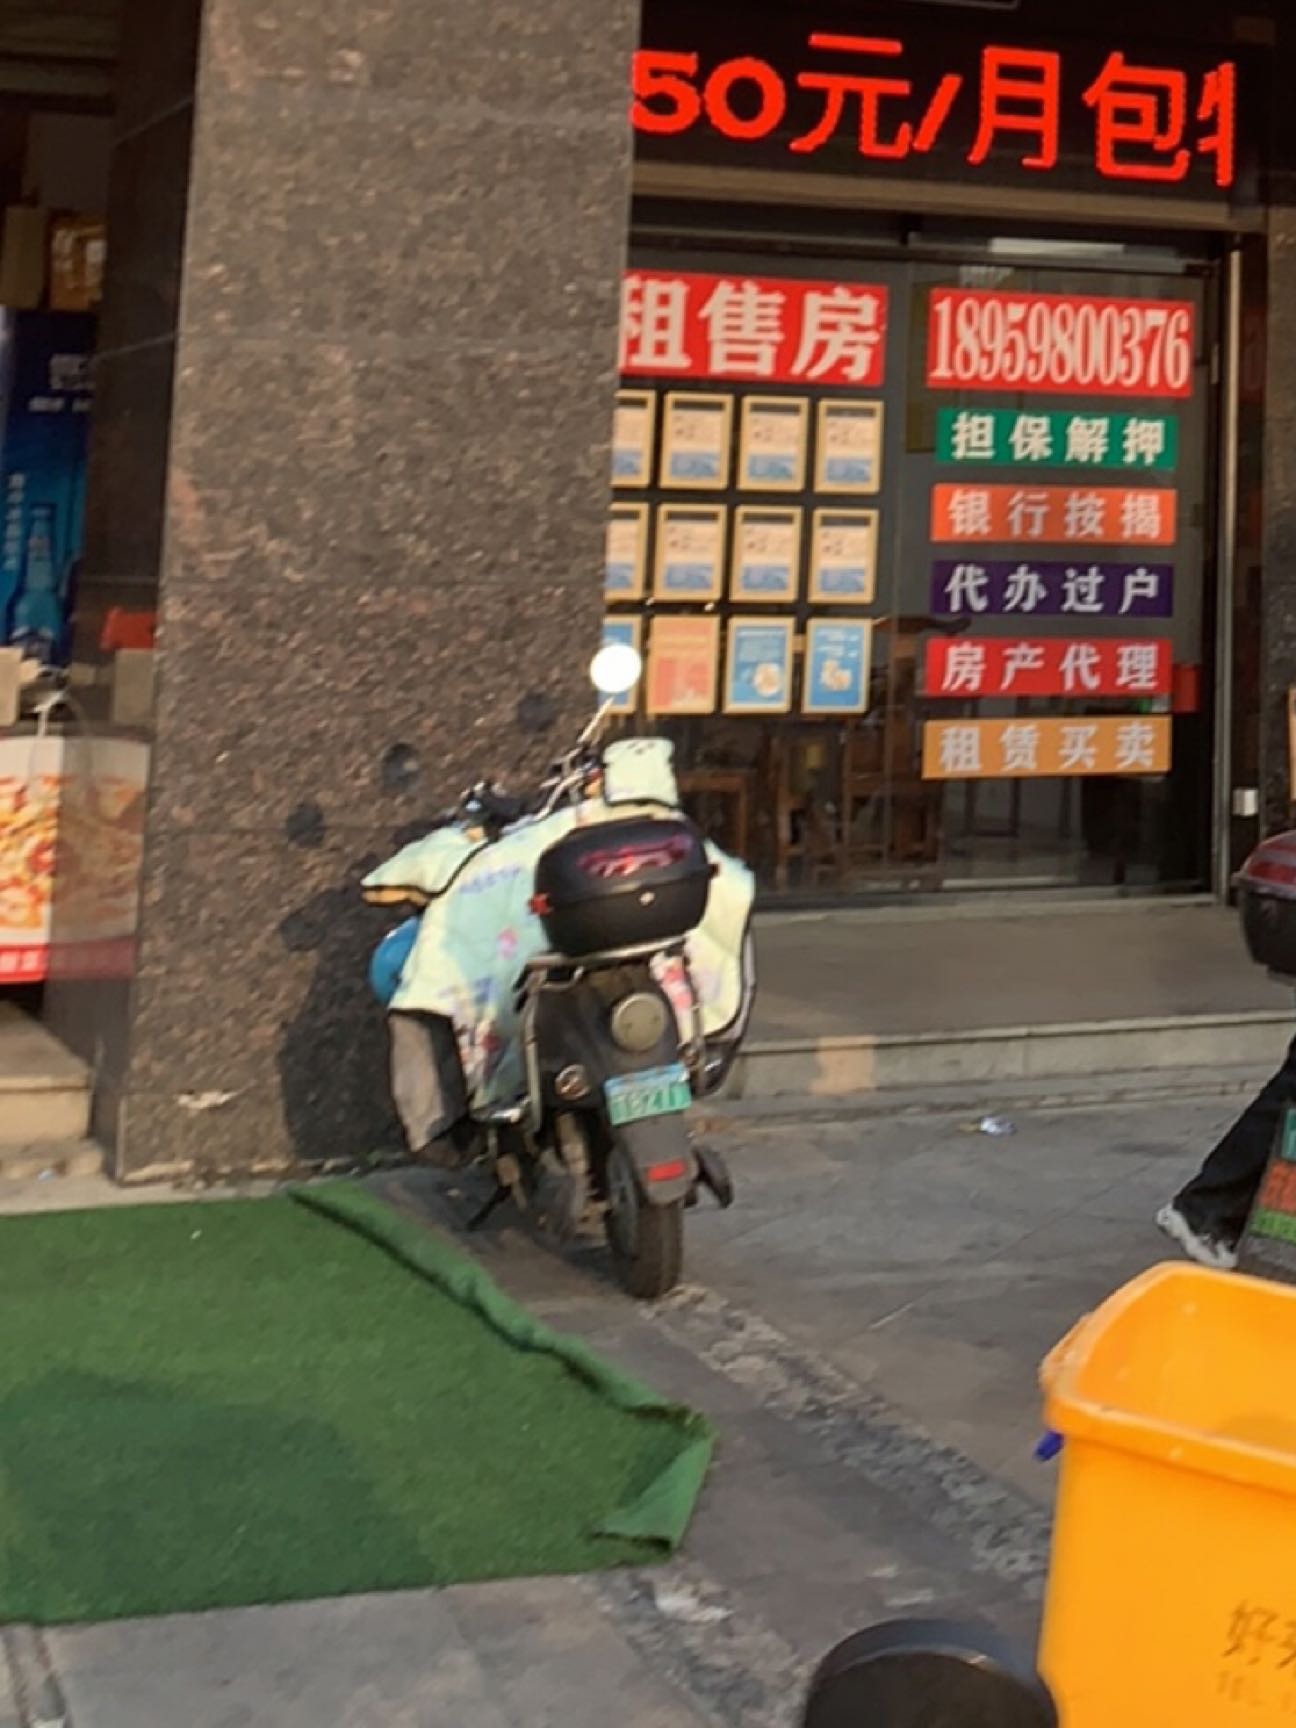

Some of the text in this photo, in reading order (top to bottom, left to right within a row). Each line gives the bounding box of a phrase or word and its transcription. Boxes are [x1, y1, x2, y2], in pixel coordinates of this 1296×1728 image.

[619, 275, 884, 382] 租售房
[932, 295, 1190, 389] 18959800376
[951, 412, 1167, 464] 担保解押
[947, 490, 1162, 539] 银行按揭
[944, 564, 1160, 614] 代办过户
[942, 643, 1159, 691] 房产代理
[939, 723, 1155, 772] 租赁买卖
